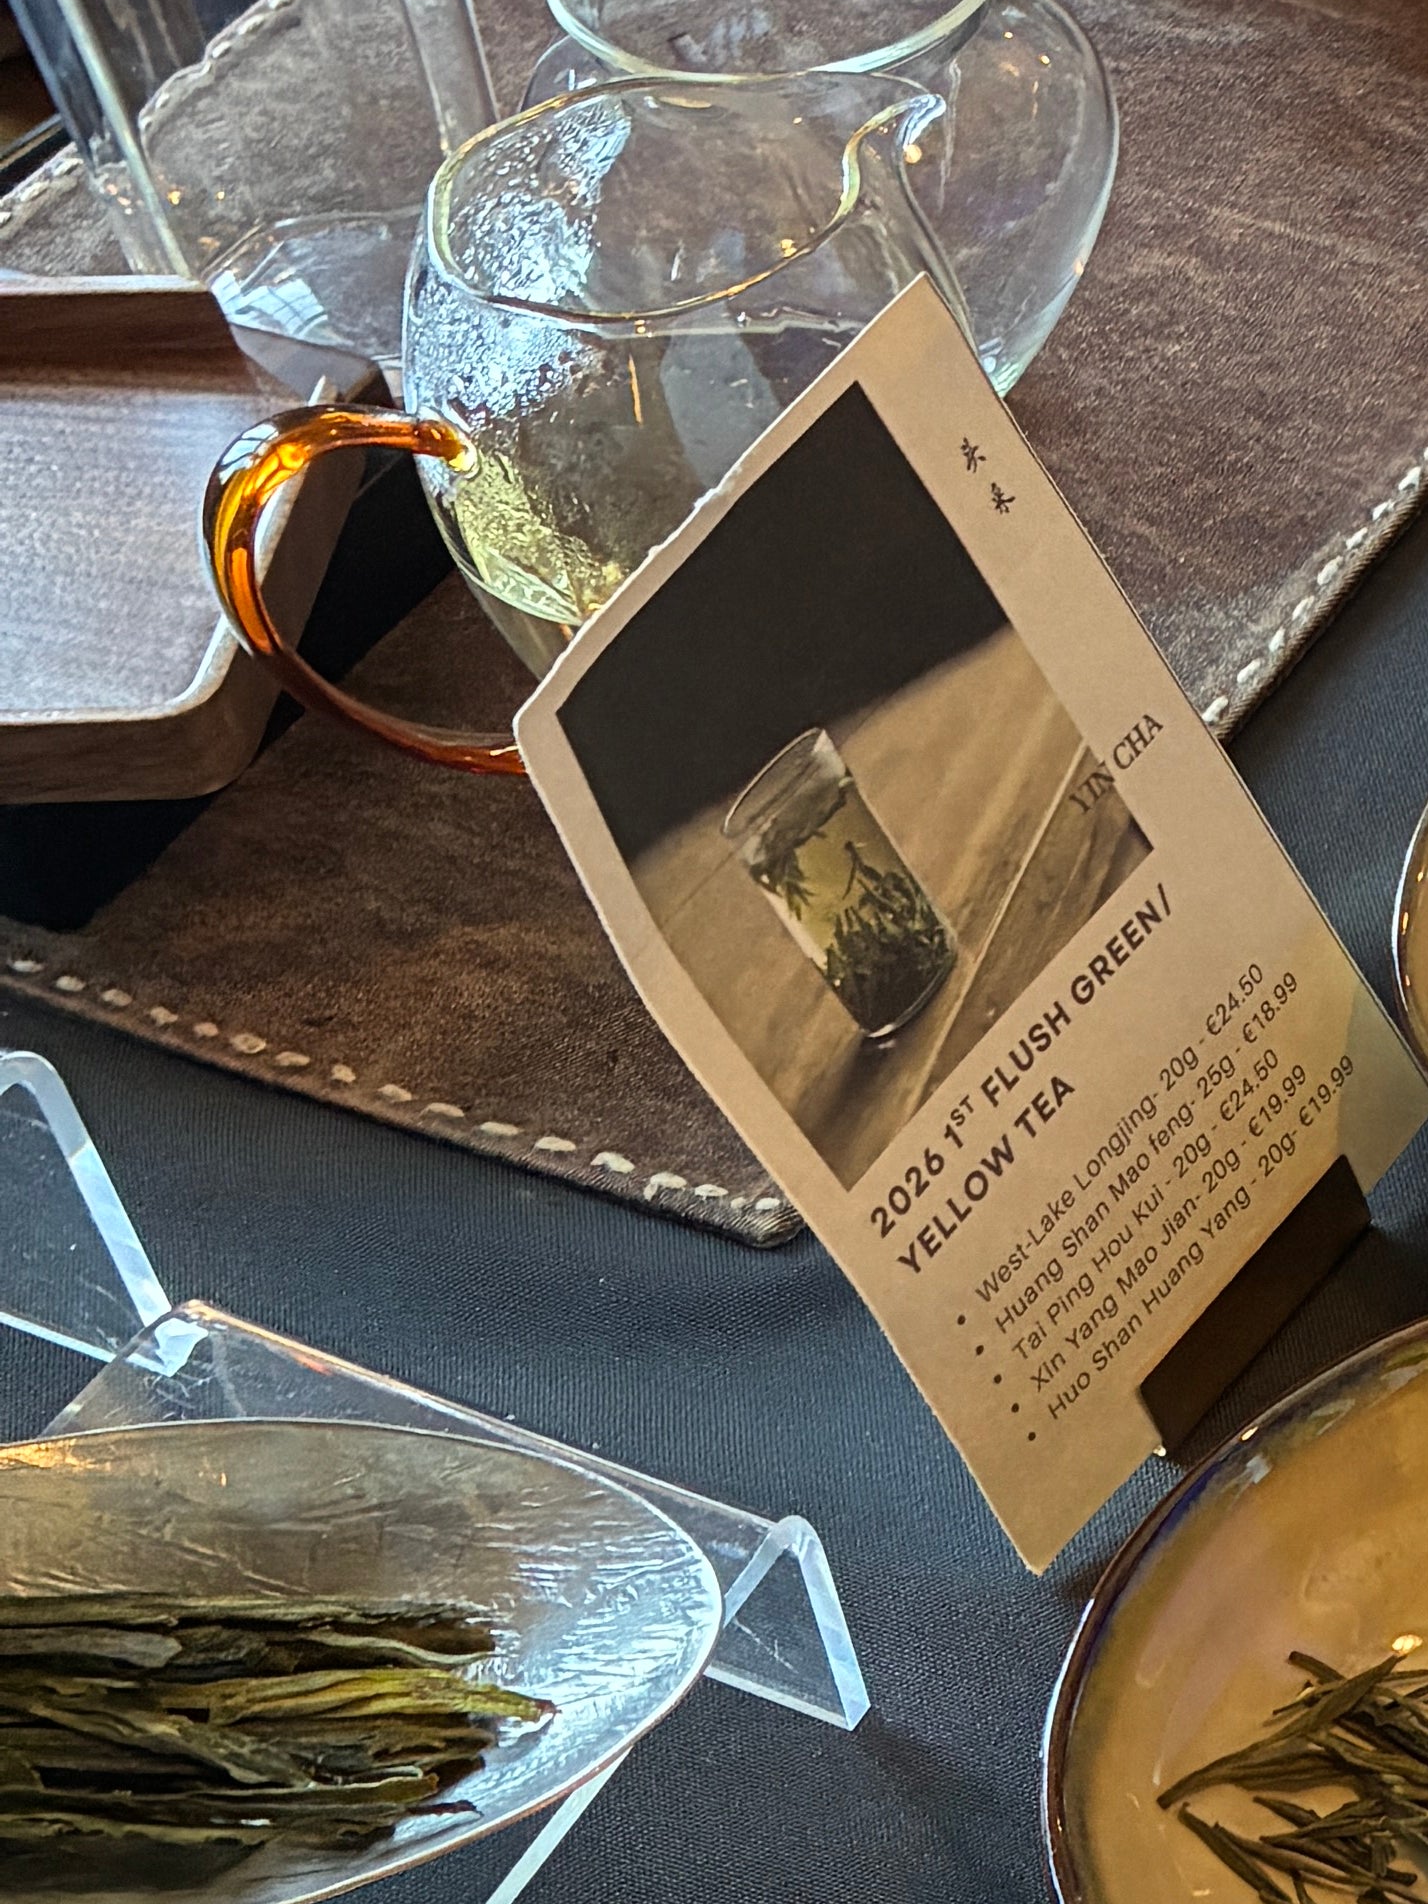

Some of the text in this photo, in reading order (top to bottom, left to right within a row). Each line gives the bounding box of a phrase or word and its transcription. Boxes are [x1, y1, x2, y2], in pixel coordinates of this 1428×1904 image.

[1069, 712, 1165, 817] YIN CHA
[869, 1146, 945, 1238] 2026
[979, 999, 1072, 1108] FLUSH
[1069, 882, 1171, 1005] GREEN/
[896, 1075, 1075, 1273] YELLOW TEA
[973, 1188, 1076, 1303] West-Lake
[1071, 1091, 1159, 1191] Longjing-
[1158, 1045, 1199, 1092] 20g
[1204, 962, 1263, 1036] €24.50
[993, 1256, 1064, 1334] Huang
[1060, 1200, 1111, 1258] Shan
[1106, 1151, 1150, 1202] Mao
[1194, 1053, 1236, 1100] 25g
[1241, 971, 1297, 1044] €18.99
[1010, 1319, 1048, 1360] Tai
[1045, 1271, 1095, 1326] Ping
[1089, 1223, 1134, 1274] Hou
[1130, 1182, 1165, 1226] Kui
[1171, 1131, 1212, 1179] 20g
[1218, 1048, 1278, 1122] €24.50
[1028, 1351, 1067, 1393] Xin
[1063, 1292, 1119, 1349] Yang
[1114, 1244, 1158, 1296] Mao
[1160, 1193, 1201, 1246] Jian-
[1200, 1147, 1241, 1194] 20g
[1247, 1063, 1306, 1137] €19.99
[1046, 1370, 1091, 1421] Huo
[1090, 1312, 1143, 1372] Shan
[1139, 1240, 1204, 1315] Huang
[1198, 1184, 1251, 1239] Yang
[1256, 1129, 1297, 1178] 20g-
[1297, 1054, 1353, 1127] €19.99
